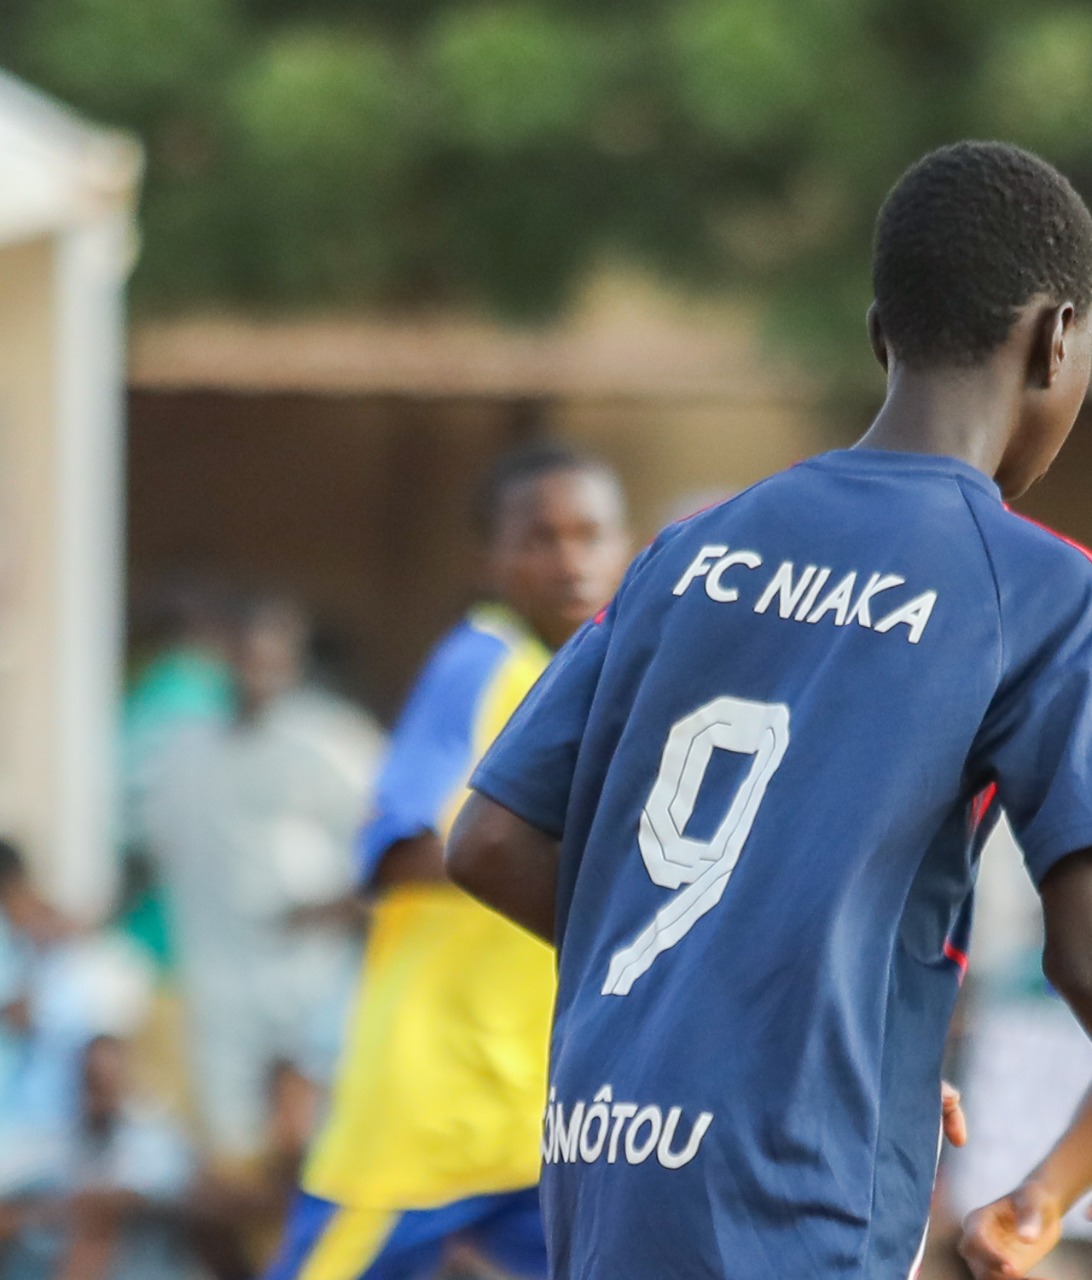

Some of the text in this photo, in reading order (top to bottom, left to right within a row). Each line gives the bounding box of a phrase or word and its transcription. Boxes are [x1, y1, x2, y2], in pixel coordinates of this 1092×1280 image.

[672, 544, 938, 645] FC NIAKA
[600, 696, 791, 996] 9
